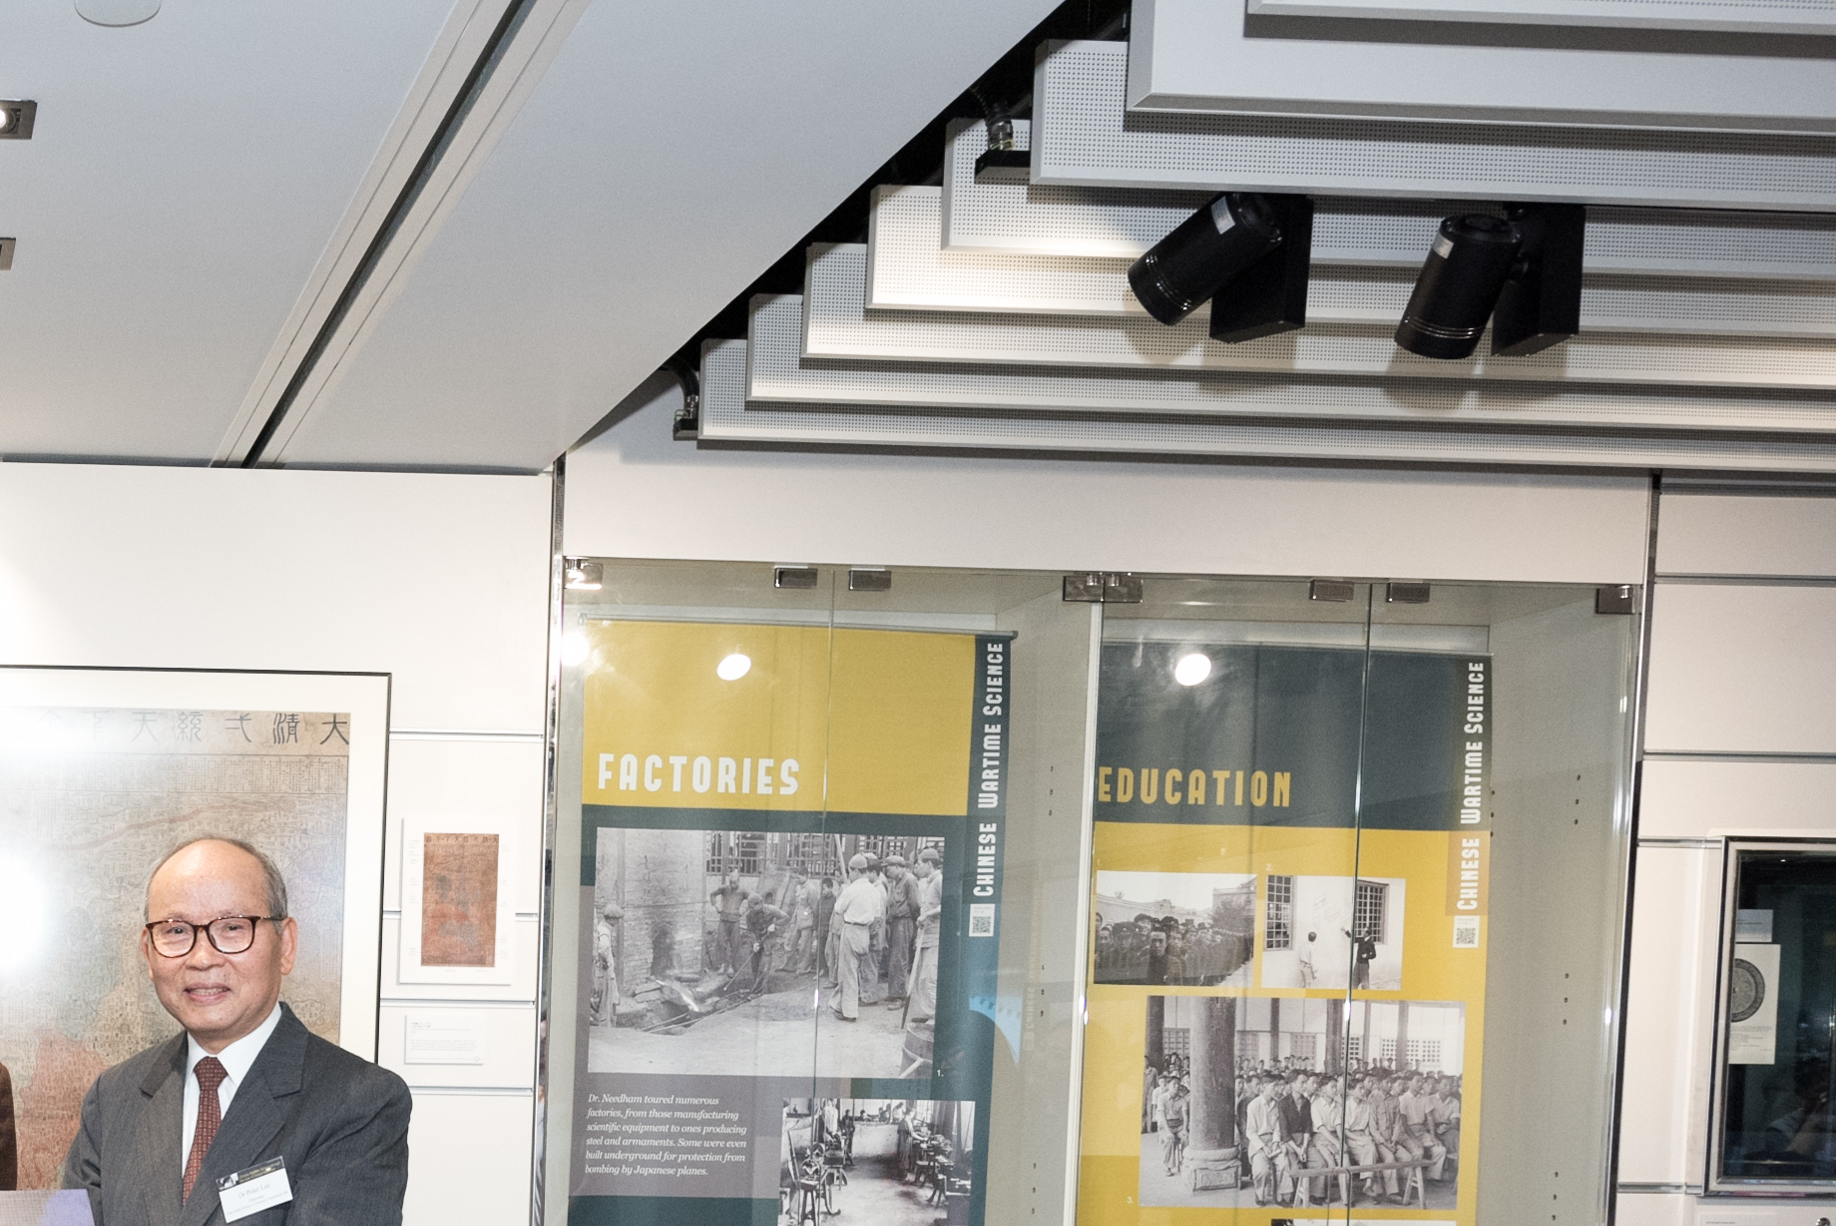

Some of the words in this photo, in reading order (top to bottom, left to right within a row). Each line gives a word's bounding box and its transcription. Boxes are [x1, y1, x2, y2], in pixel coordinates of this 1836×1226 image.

[982, 643, 1003, 716] SCIENCE
[1464, 662, 1484, 734] SCIENCE
[598, 752, 799, 795] FACTORIES
[978, 723, 1002, 809] WARTIME
[1098, 766, 1291, 808] EDUCATION
[1460, 741, 1482, 824] WARTIME
[973, 822, 997, 897] CHINESE
[1456, 838, 1480, 910] CHINESE
[586, 1108, 624, 1118] factories,
[623, 1108, 647, 1119] from
[649, 1109, 672, 1118] those
[674, 1110, 739, 1121] manufacturing
[588, 1094, 600, 1102] Dr.
[601, 1094, 642, 1103] Needham
[644, 1095, 674, 1104] toured
[585, 1164, 620, 1175] bombing
[621, 1165, 633, 1175] by
[634, 1165, 676, 1176] Japanese
[677, 1166, 708, 1177] planes.
